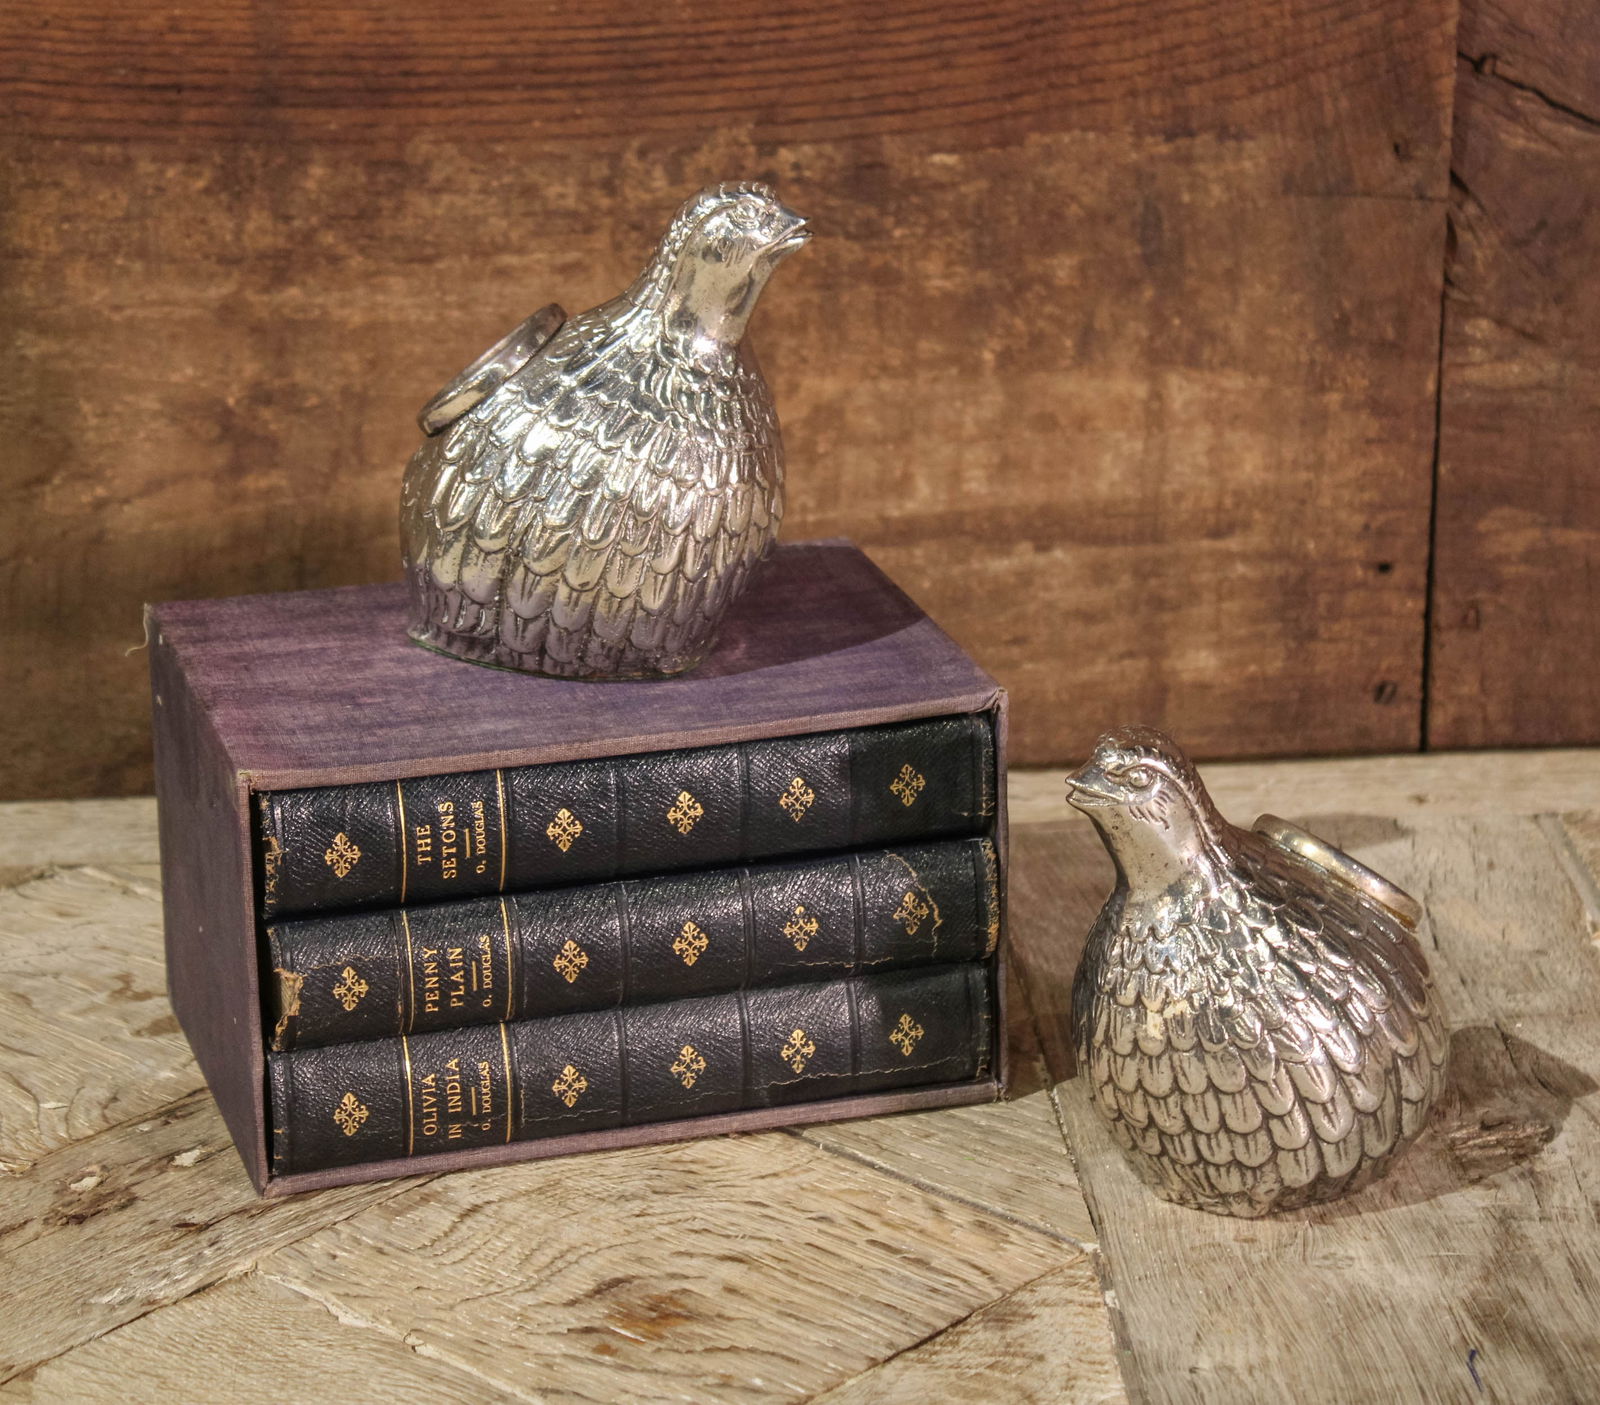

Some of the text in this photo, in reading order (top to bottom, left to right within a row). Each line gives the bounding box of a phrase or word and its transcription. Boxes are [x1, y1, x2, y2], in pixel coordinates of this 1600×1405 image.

[416, 825, 431, 865] THE
[439, 801, 457, 879] SETONS
[473, 800, 487, 873] O. DOUGLAS
[424, 947, 440, 1012] PENNY
[448, 947, 465, 1007] PLAIN
[480, 936, 492, 1007] O. DOUGLAS
[422, 1074, 438, 1135] OLIVIA
[445, 1058, 462, 1139] IN INDIA
[478, 1061, 491, 1131] O. DOUGLAS
